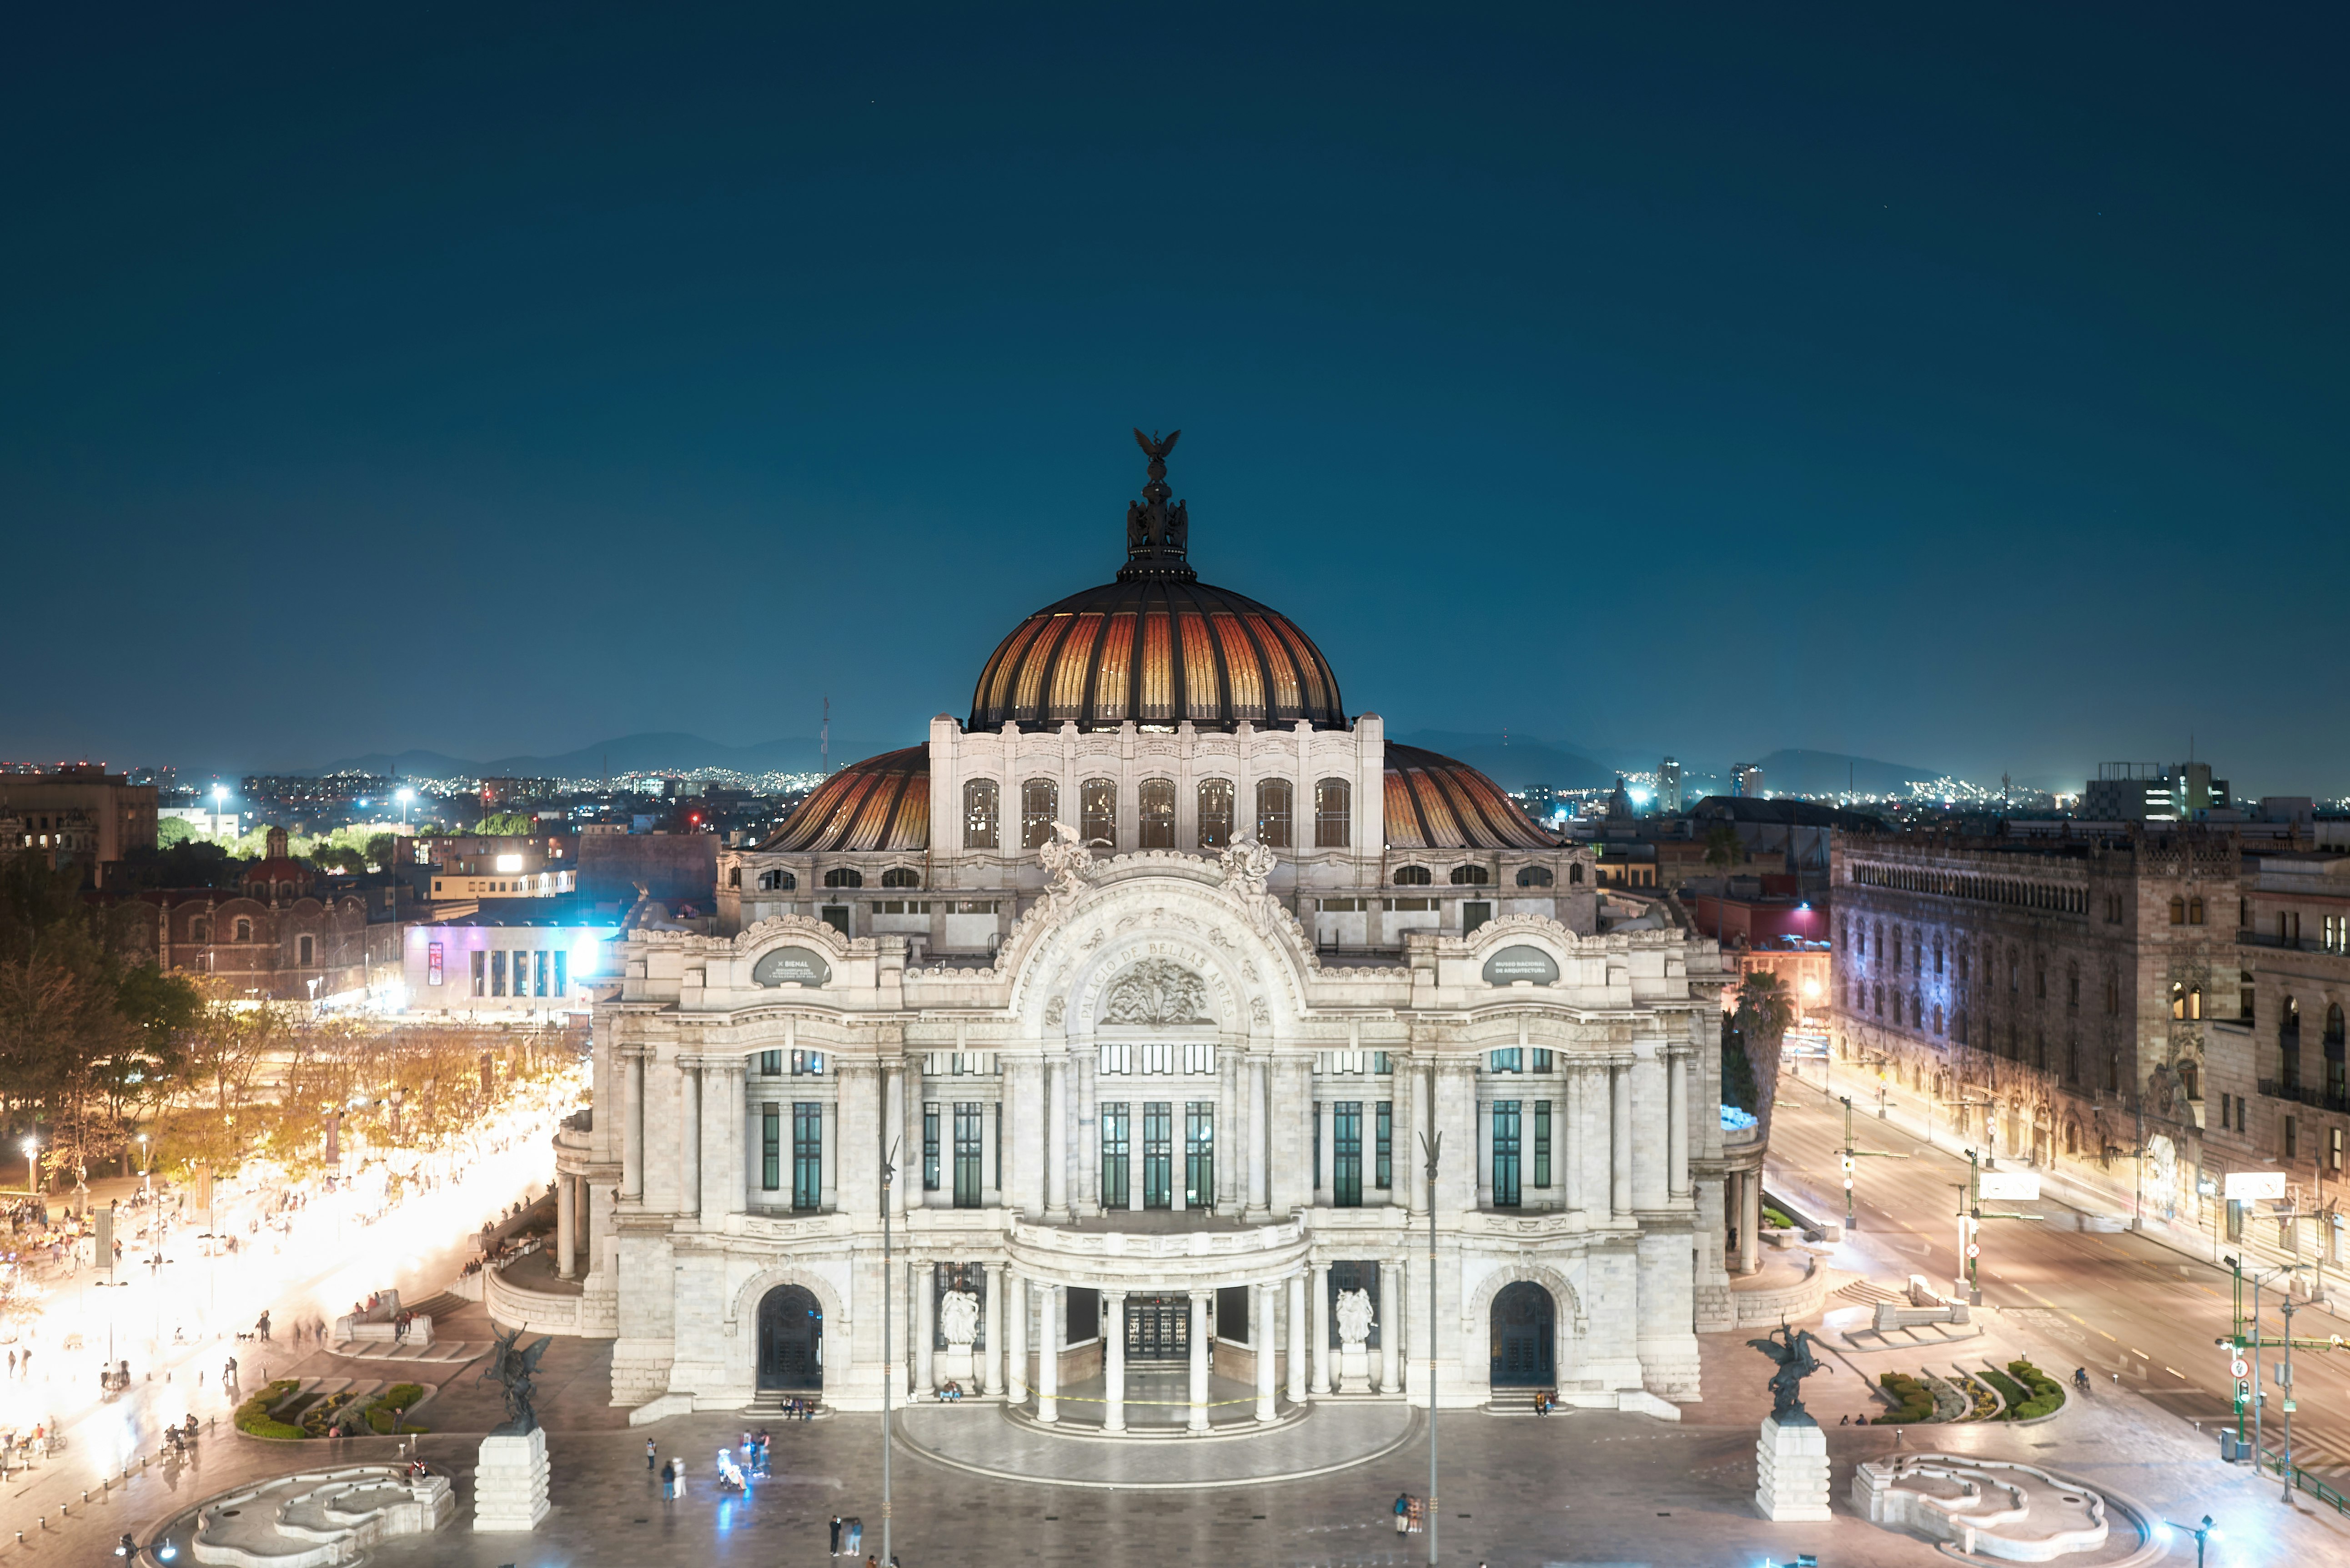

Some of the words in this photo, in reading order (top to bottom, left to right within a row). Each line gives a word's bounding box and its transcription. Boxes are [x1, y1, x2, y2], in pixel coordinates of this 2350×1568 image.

[1081, 960, 1115, 1018] PALACIO
[1121, 946, 1140, 962] DE
[1150, 943, 1205, 968] BELLAS
[1209, 973, 1234, 1017] ARTES
